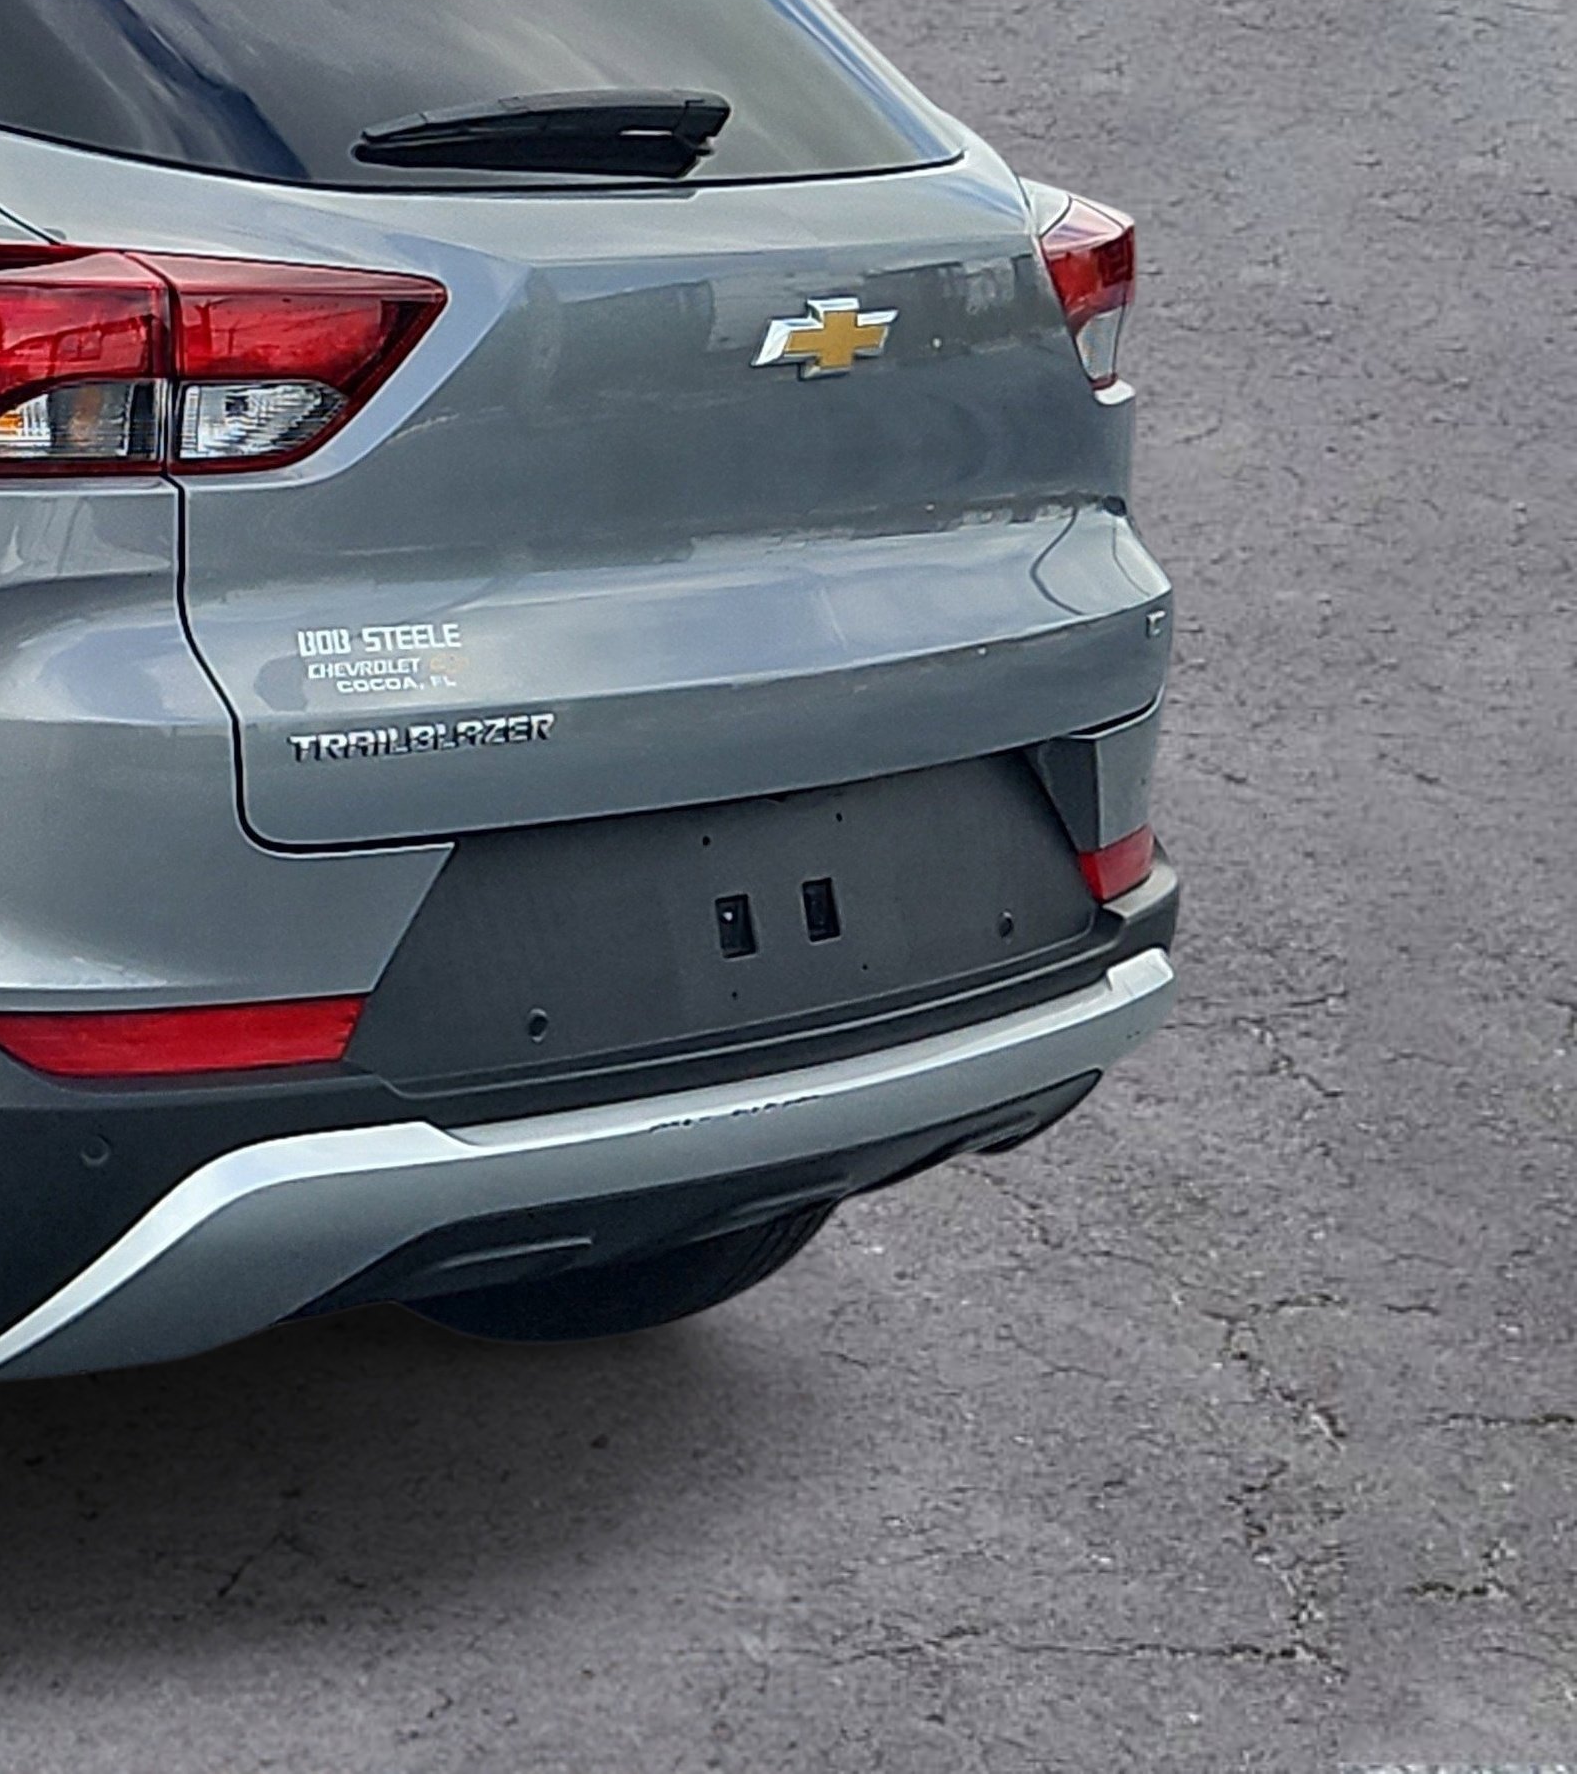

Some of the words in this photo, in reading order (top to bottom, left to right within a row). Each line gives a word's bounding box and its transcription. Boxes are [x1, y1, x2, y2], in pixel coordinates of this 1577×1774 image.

[297, 628, 352, 658] BOB
[361, 623, 463, 653] STEELE
[307, 657, 422, 680] CHEVROLET
[336, 676, 425, 694] COCOA,
[288, 712, 555, 762] TRAILBLAZER
